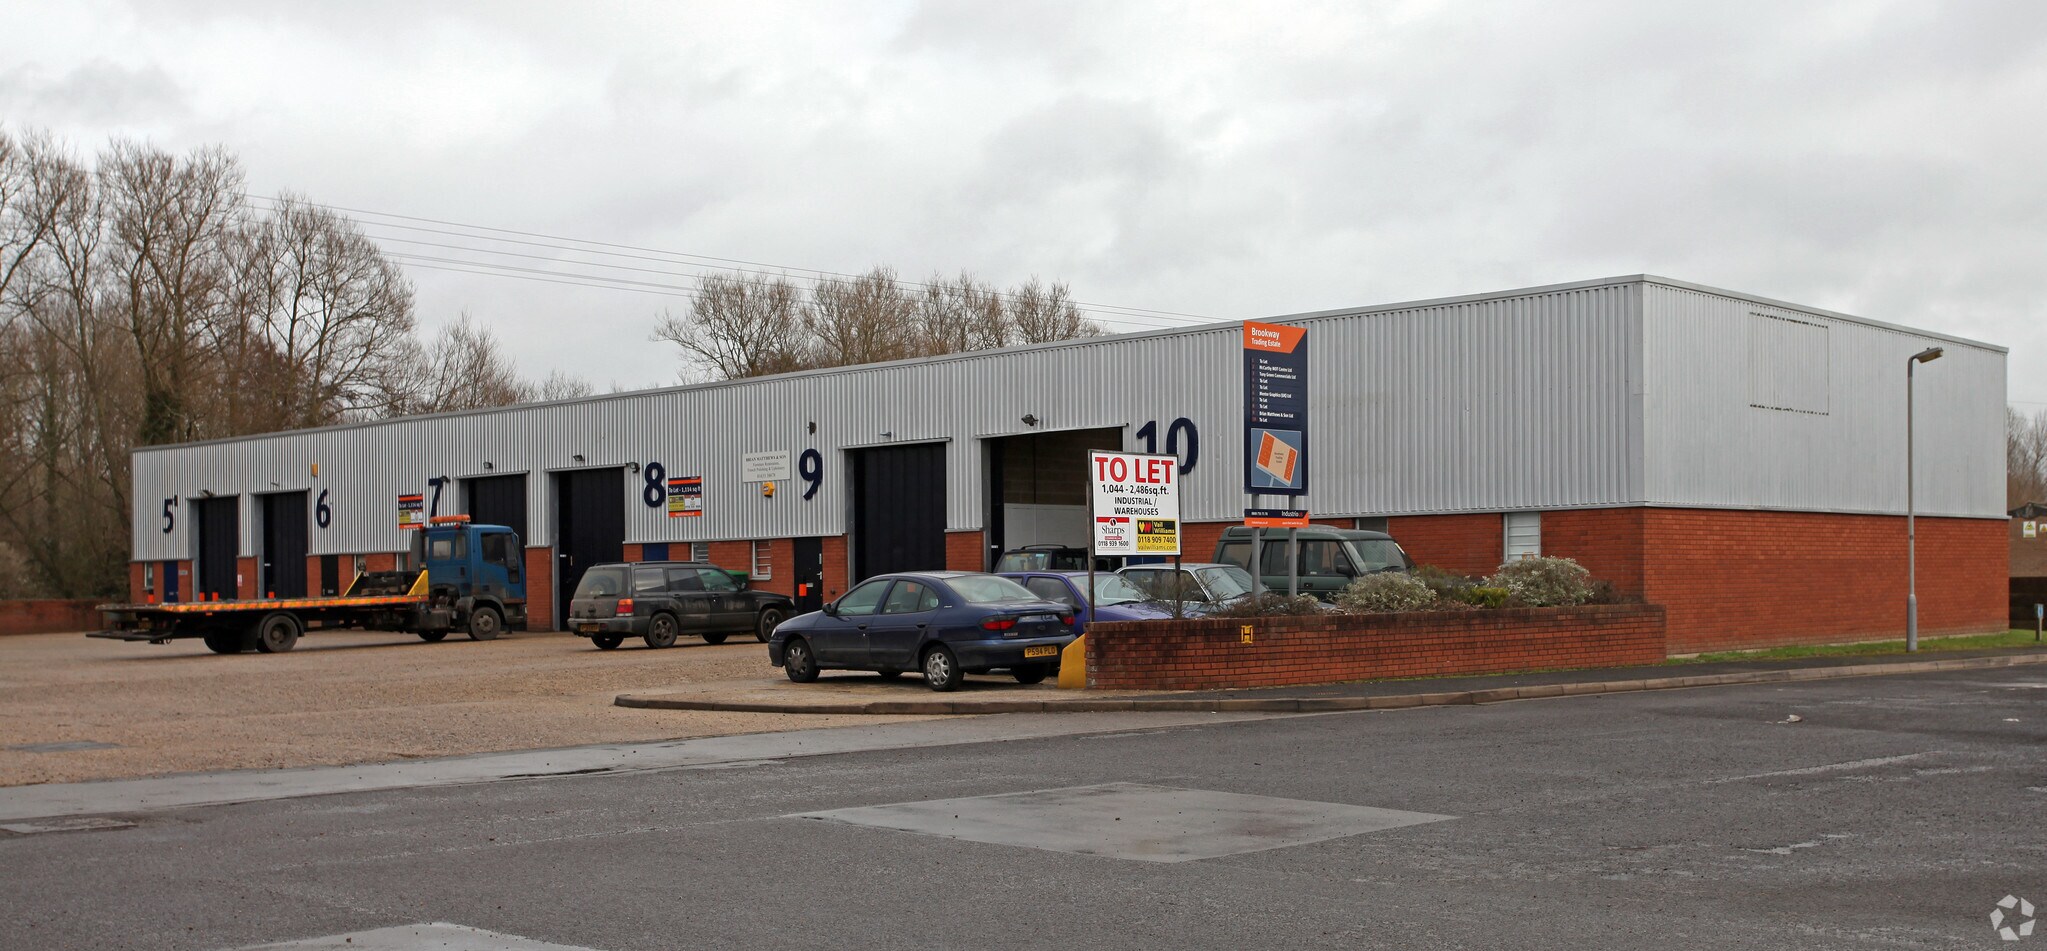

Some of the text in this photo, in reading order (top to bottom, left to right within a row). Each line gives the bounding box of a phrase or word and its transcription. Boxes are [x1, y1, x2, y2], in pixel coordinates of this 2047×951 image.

[1251, 327, 1280, 340] Brookway
[1251, 338, 1281, 348] Trading Estate
[1136, 417, 1199, 475] 10
[799, 449, 823, 501] 9
[1095, 457, 1174, 484] TO LET
[644, 462, 666, 507] 8
[1102, 484, 1124, 494] 1,044
[1130, 485, 1169, 497] 2,486sq.ft.
[428, 478, 443, 517] 7
[1115, 497, 1152, 505] INDUSTRIAL
[316, 488, 331, 528] 6
[1114, 507, 1159, 516] WAREHOUSES
[163, 499, 173, 534] 5
[1101, 525, 1125, 536] Sharps
[1242, 627, 1252, 642] H
[1027, 647, 1043, 656] P594
